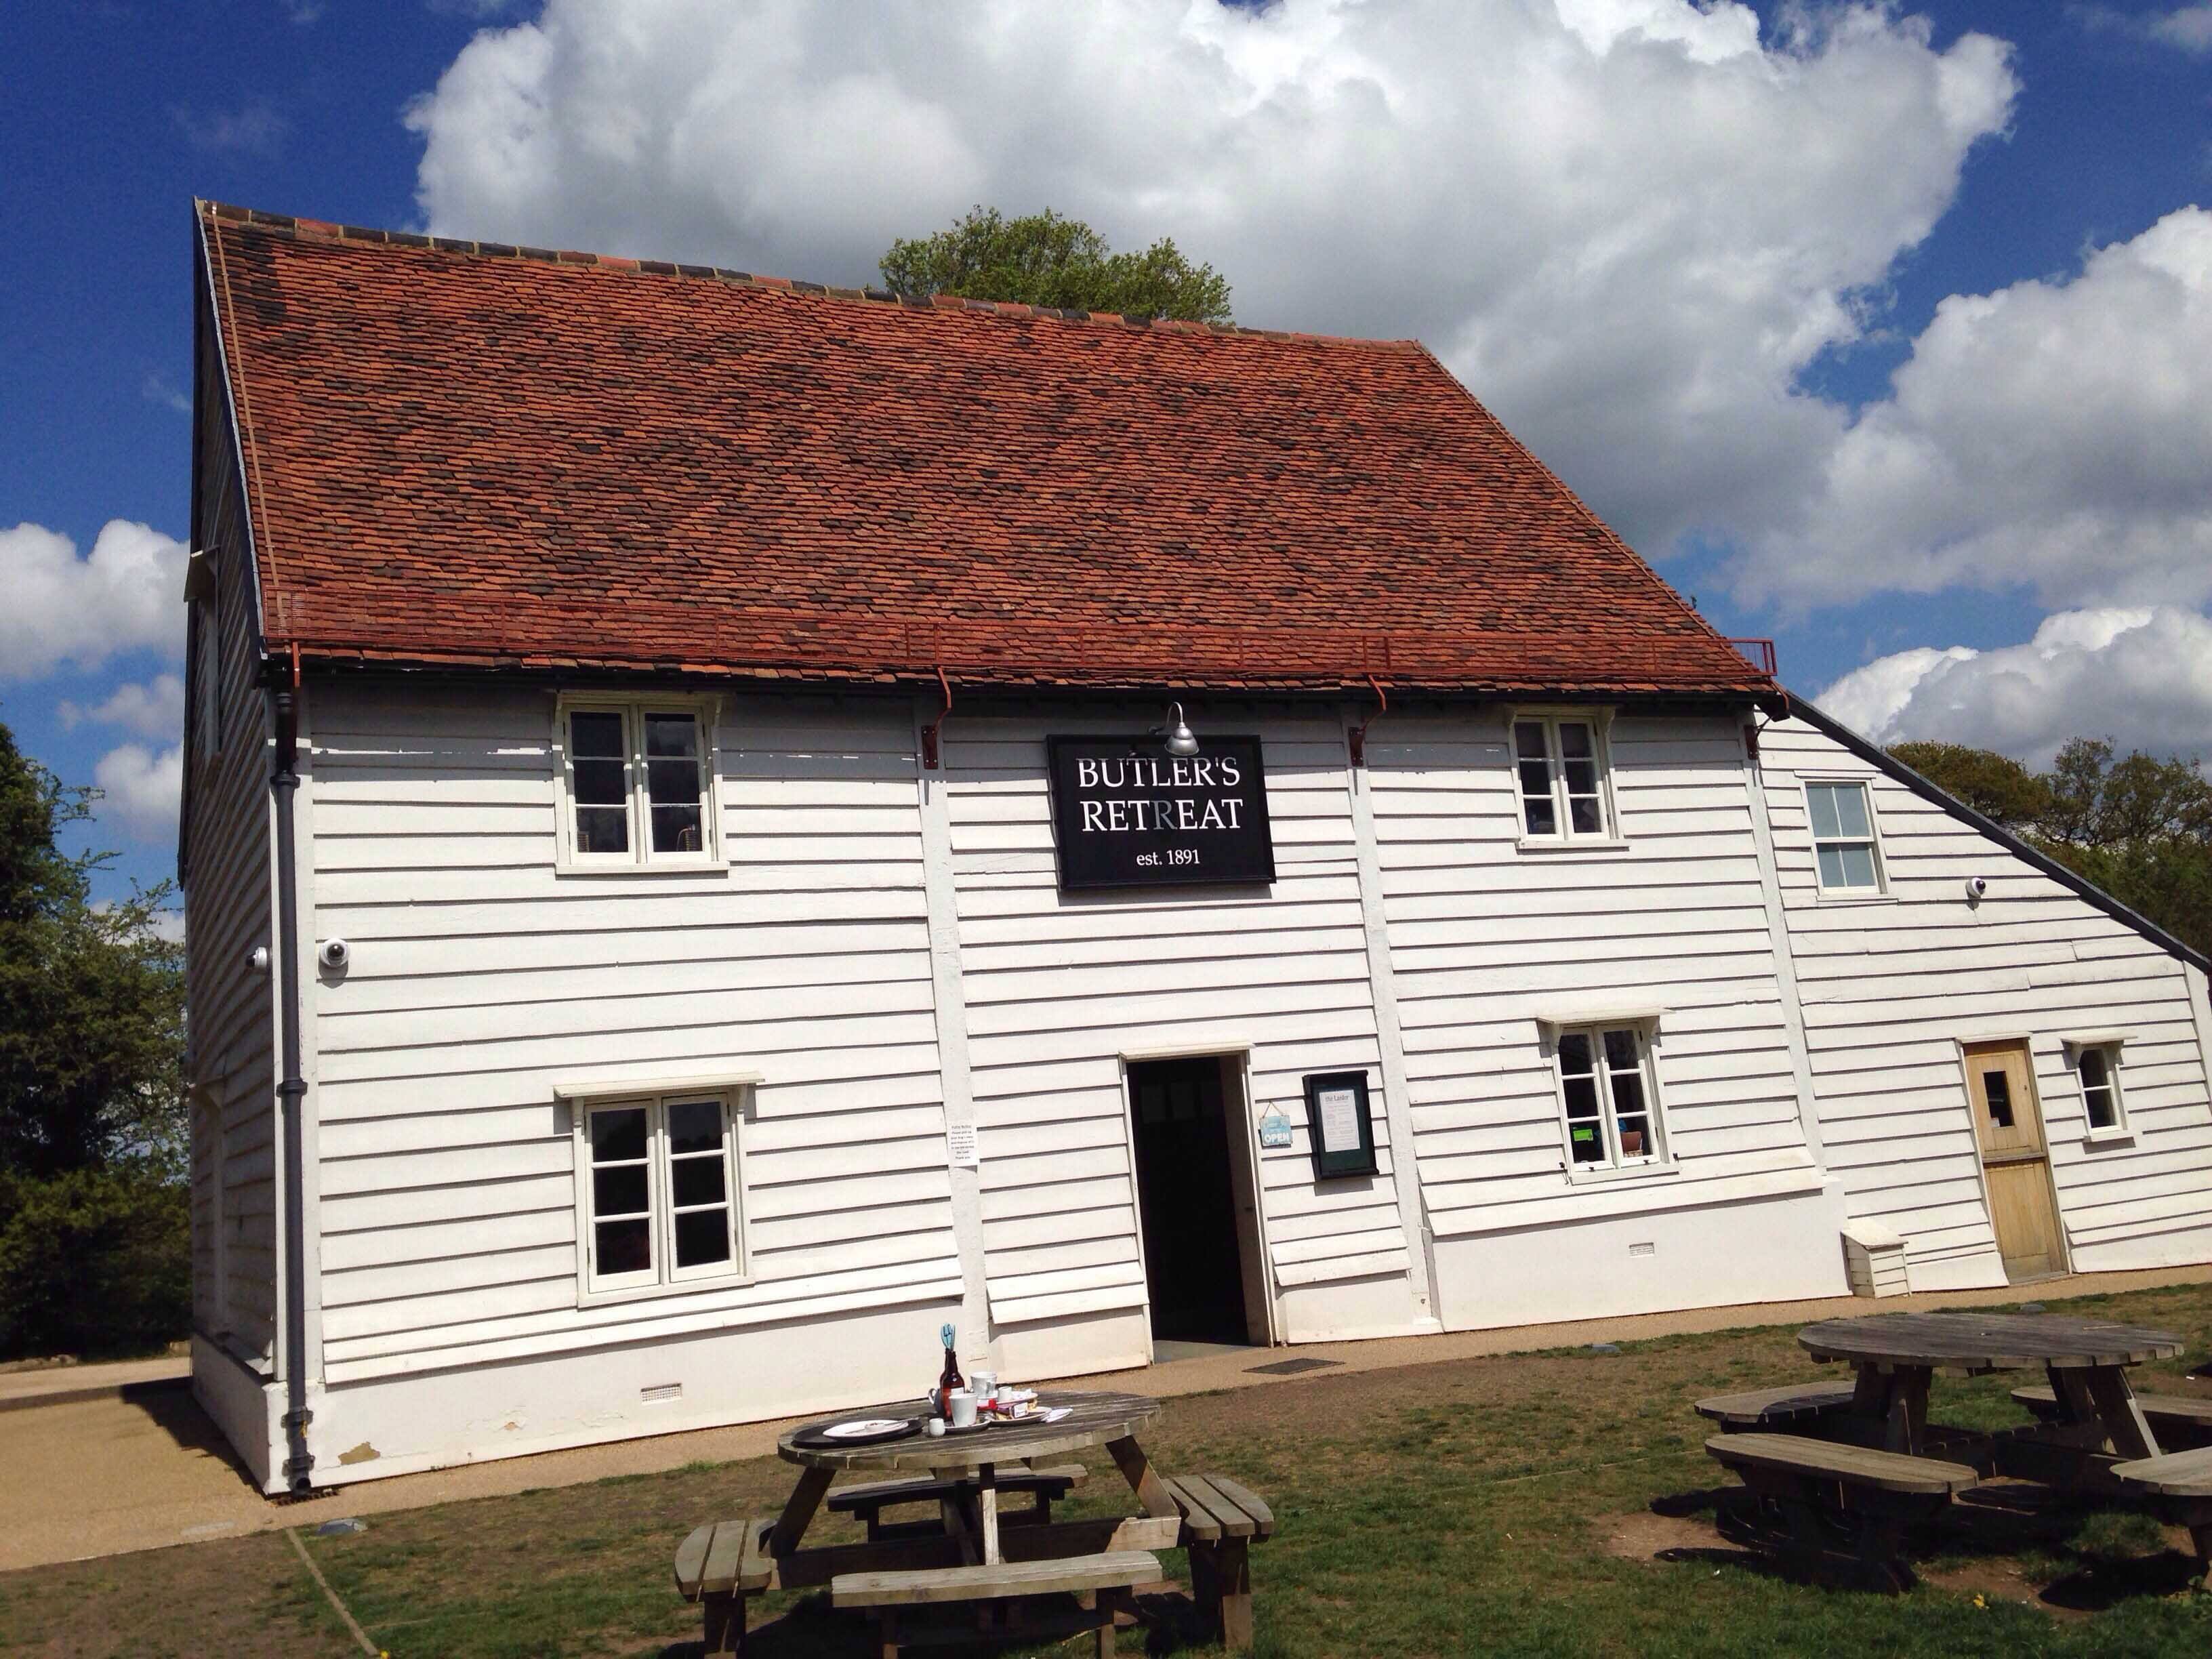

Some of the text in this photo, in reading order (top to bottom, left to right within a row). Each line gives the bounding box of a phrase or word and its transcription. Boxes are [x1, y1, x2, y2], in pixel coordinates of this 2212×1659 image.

[1076, 756, 1240, 787] BUTLER'S
[1080, 798, 1243, 832] RETREAT
[1136, 848, 1201, 866] est. 1891
[1264, 1132, 1290, 1143] OPEN
